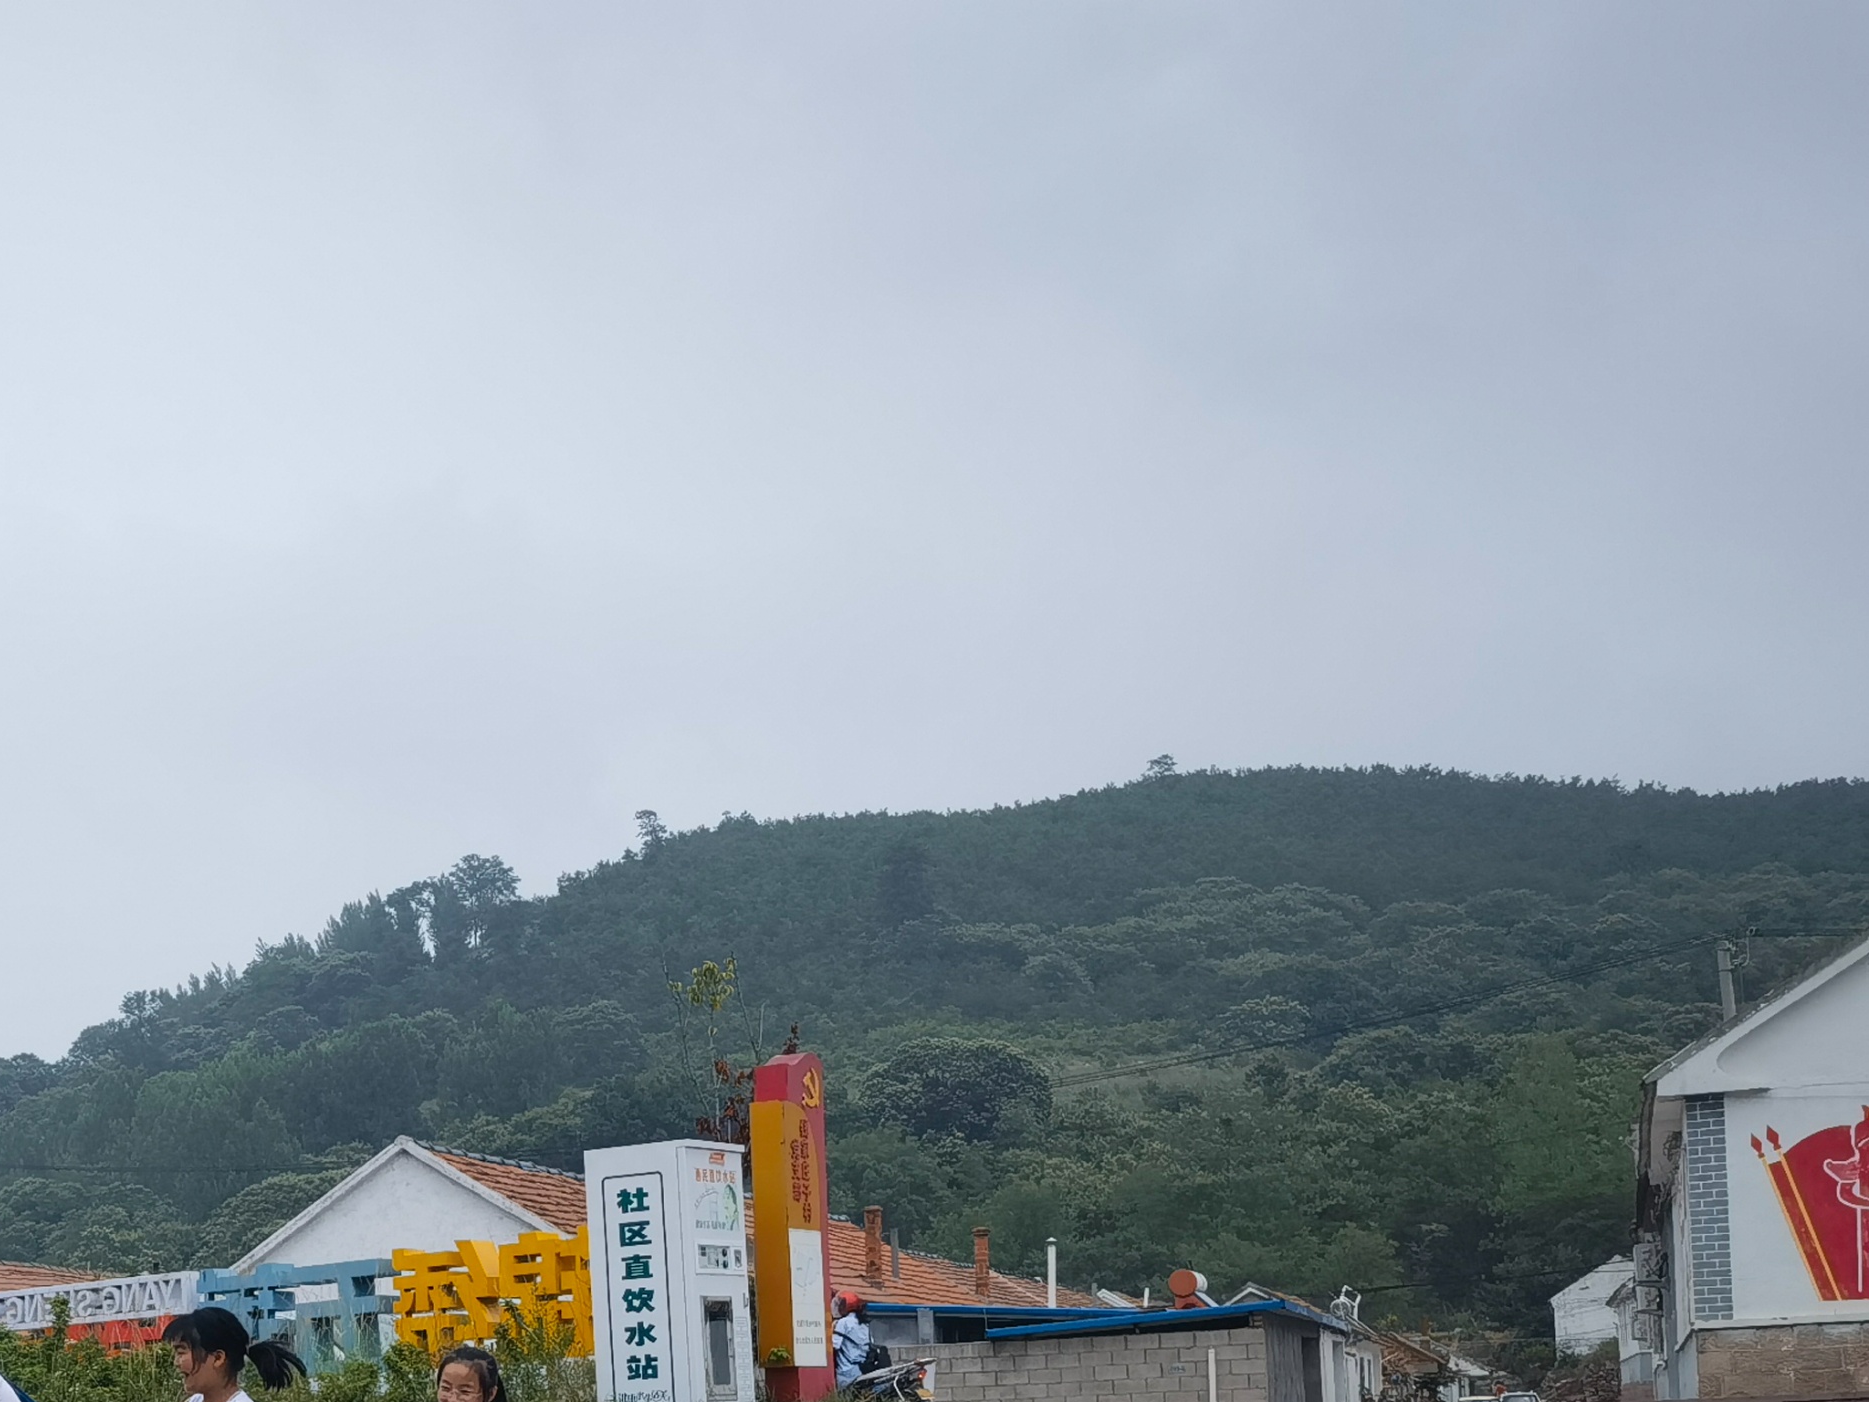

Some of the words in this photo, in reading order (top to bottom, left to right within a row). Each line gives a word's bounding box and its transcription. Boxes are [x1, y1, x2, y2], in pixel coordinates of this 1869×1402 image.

[616, 1186, 659, 1381] 社区直饮水站
